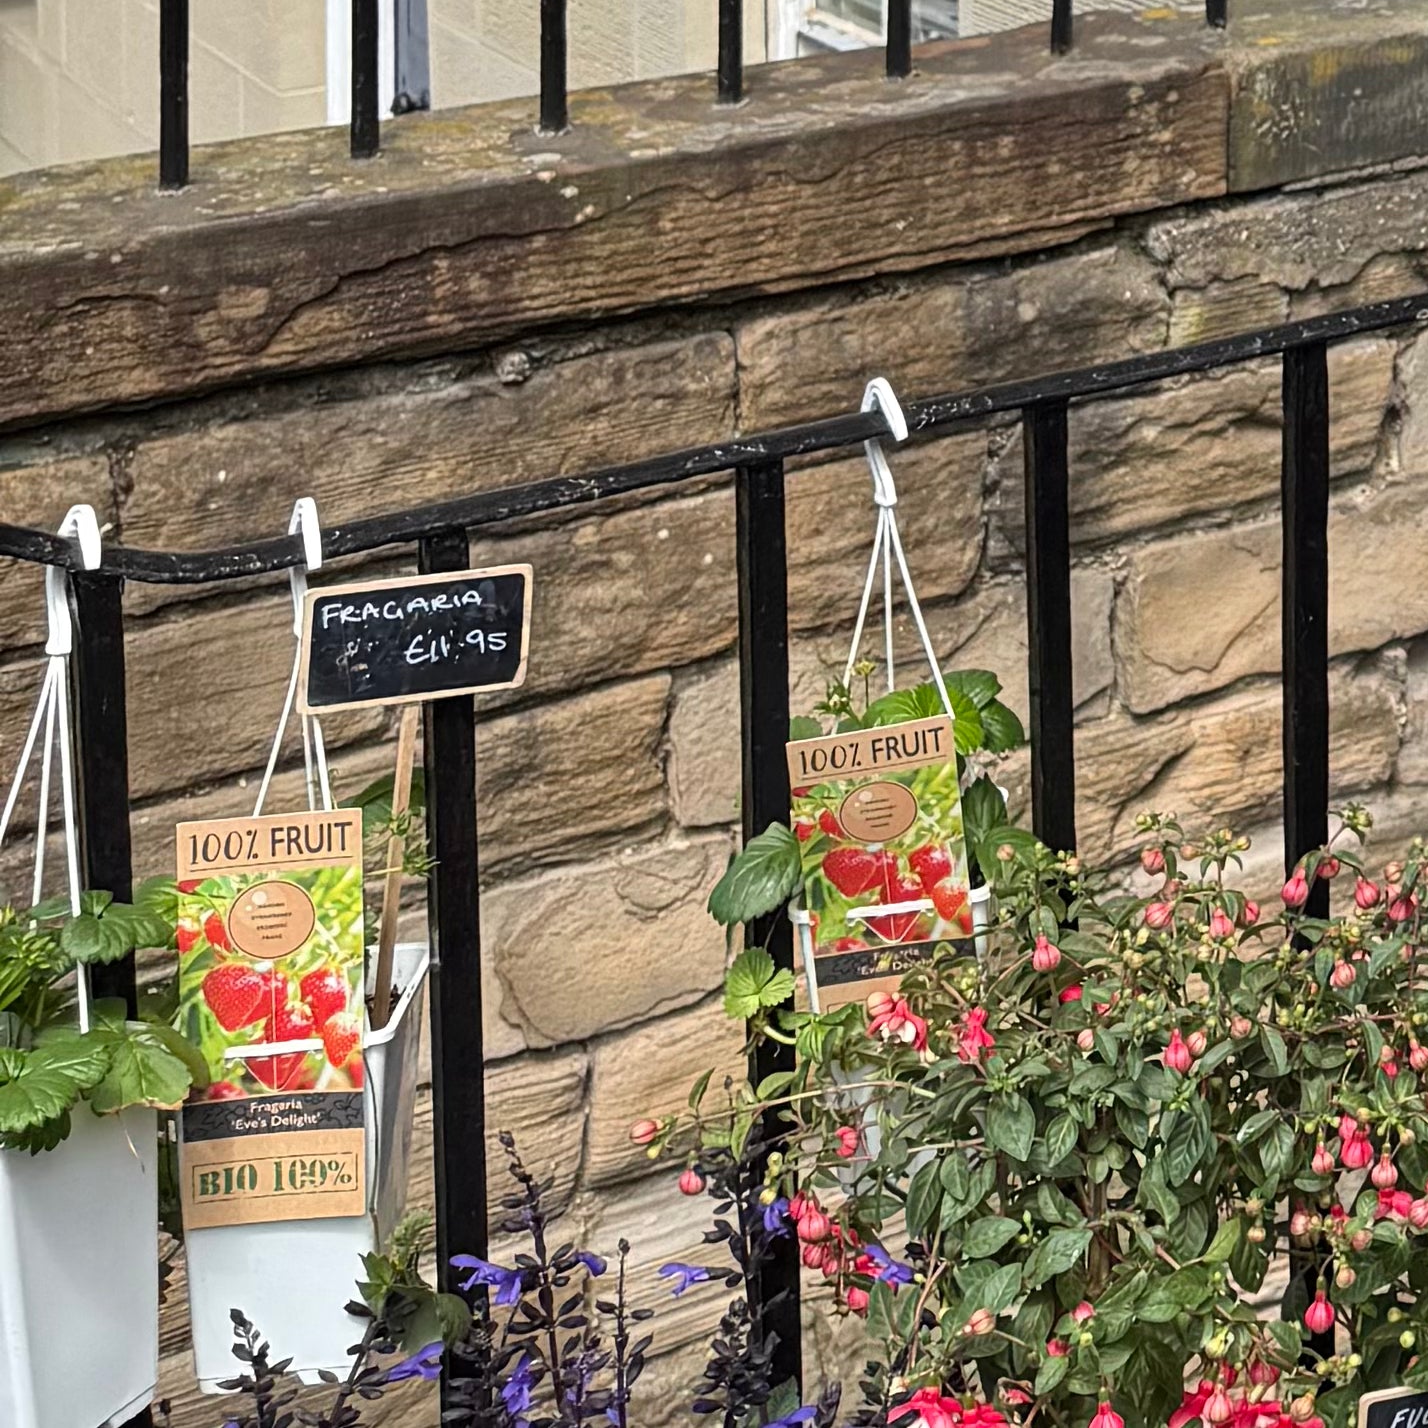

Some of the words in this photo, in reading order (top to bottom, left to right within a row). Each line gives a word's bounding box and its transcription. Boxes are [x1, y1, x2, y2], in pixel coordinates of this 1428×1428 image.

[321, 589, 483, 630] FRAGARIA
[799, 743, 862, 775] 100%
[871, 726, 945, 764] FRUIT
[188, 828, 260, 865] 100%
[270, 821, 354, 858] FRUIT
[249, 1097, 304, 1115] Fragaria
[198, 1163, 258, 1197] BIO
[273, 1158, 353, 1193] 100%
